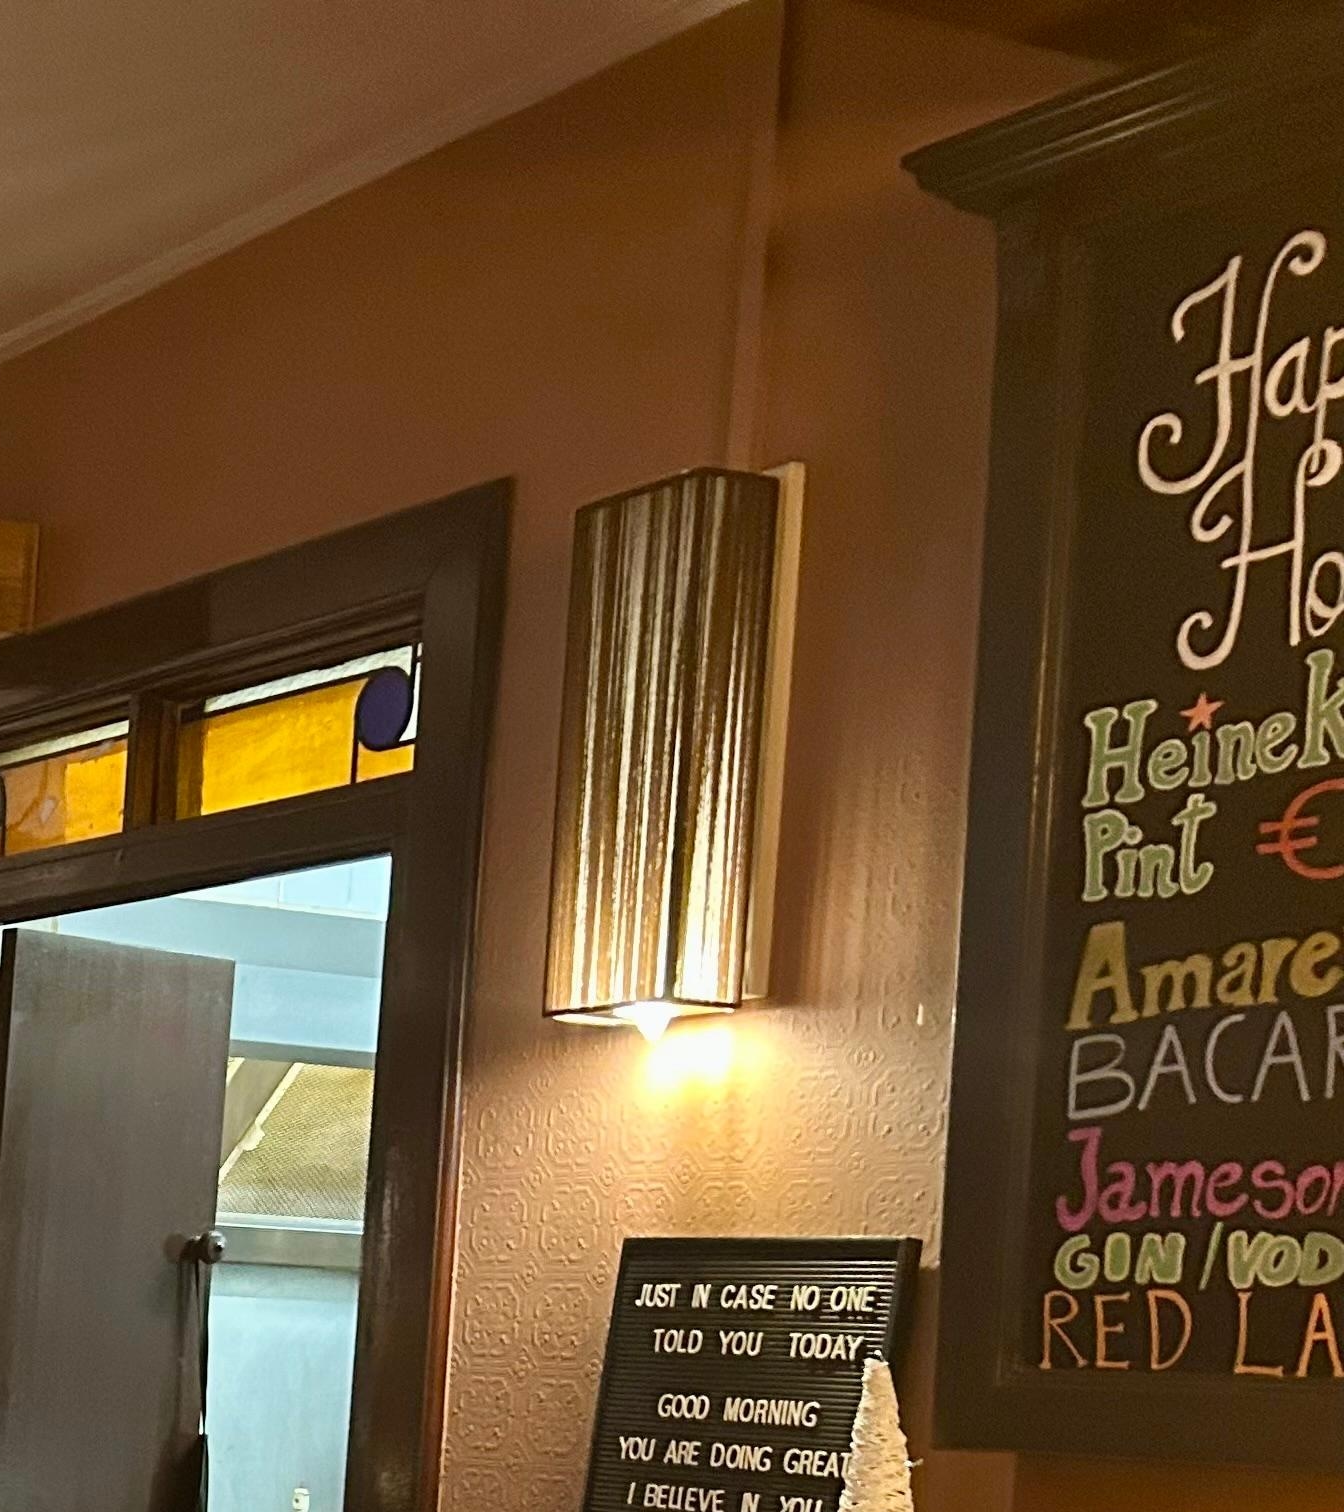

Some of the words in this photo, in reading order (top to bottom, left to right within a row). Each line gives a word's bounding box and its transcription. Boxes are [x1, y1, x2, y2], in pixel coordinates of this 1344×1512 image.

[1082, 793, 1217, 901] Pint
[635, 1283, 681, 1308] JUST
[691, 1283, 712, 1309] IN
[720, 1284, 778, 1310] CASE
[790, 1284, 821, 1311] NO
[830, 1286, 878, 1313] ONE
[653, 1328, 703, 1354] TOLD
[719, 1330, 763, 1357] YOU
[789, 1332, 864, 1361] TODAY
[1038, 1289, 1193, 1371] RED
[658, 1393, 710, 1420] GOOD
[723, 1397, 821, 1427] MORNING
[619, 1436, 656, 1461] YOU
[663, 1440, 702, 1466] ARE
[710, 1442, 773, 1472] DOING
[783, 1448, 853, 1478] GREAT
[627, 1482, 636, 1504] I
